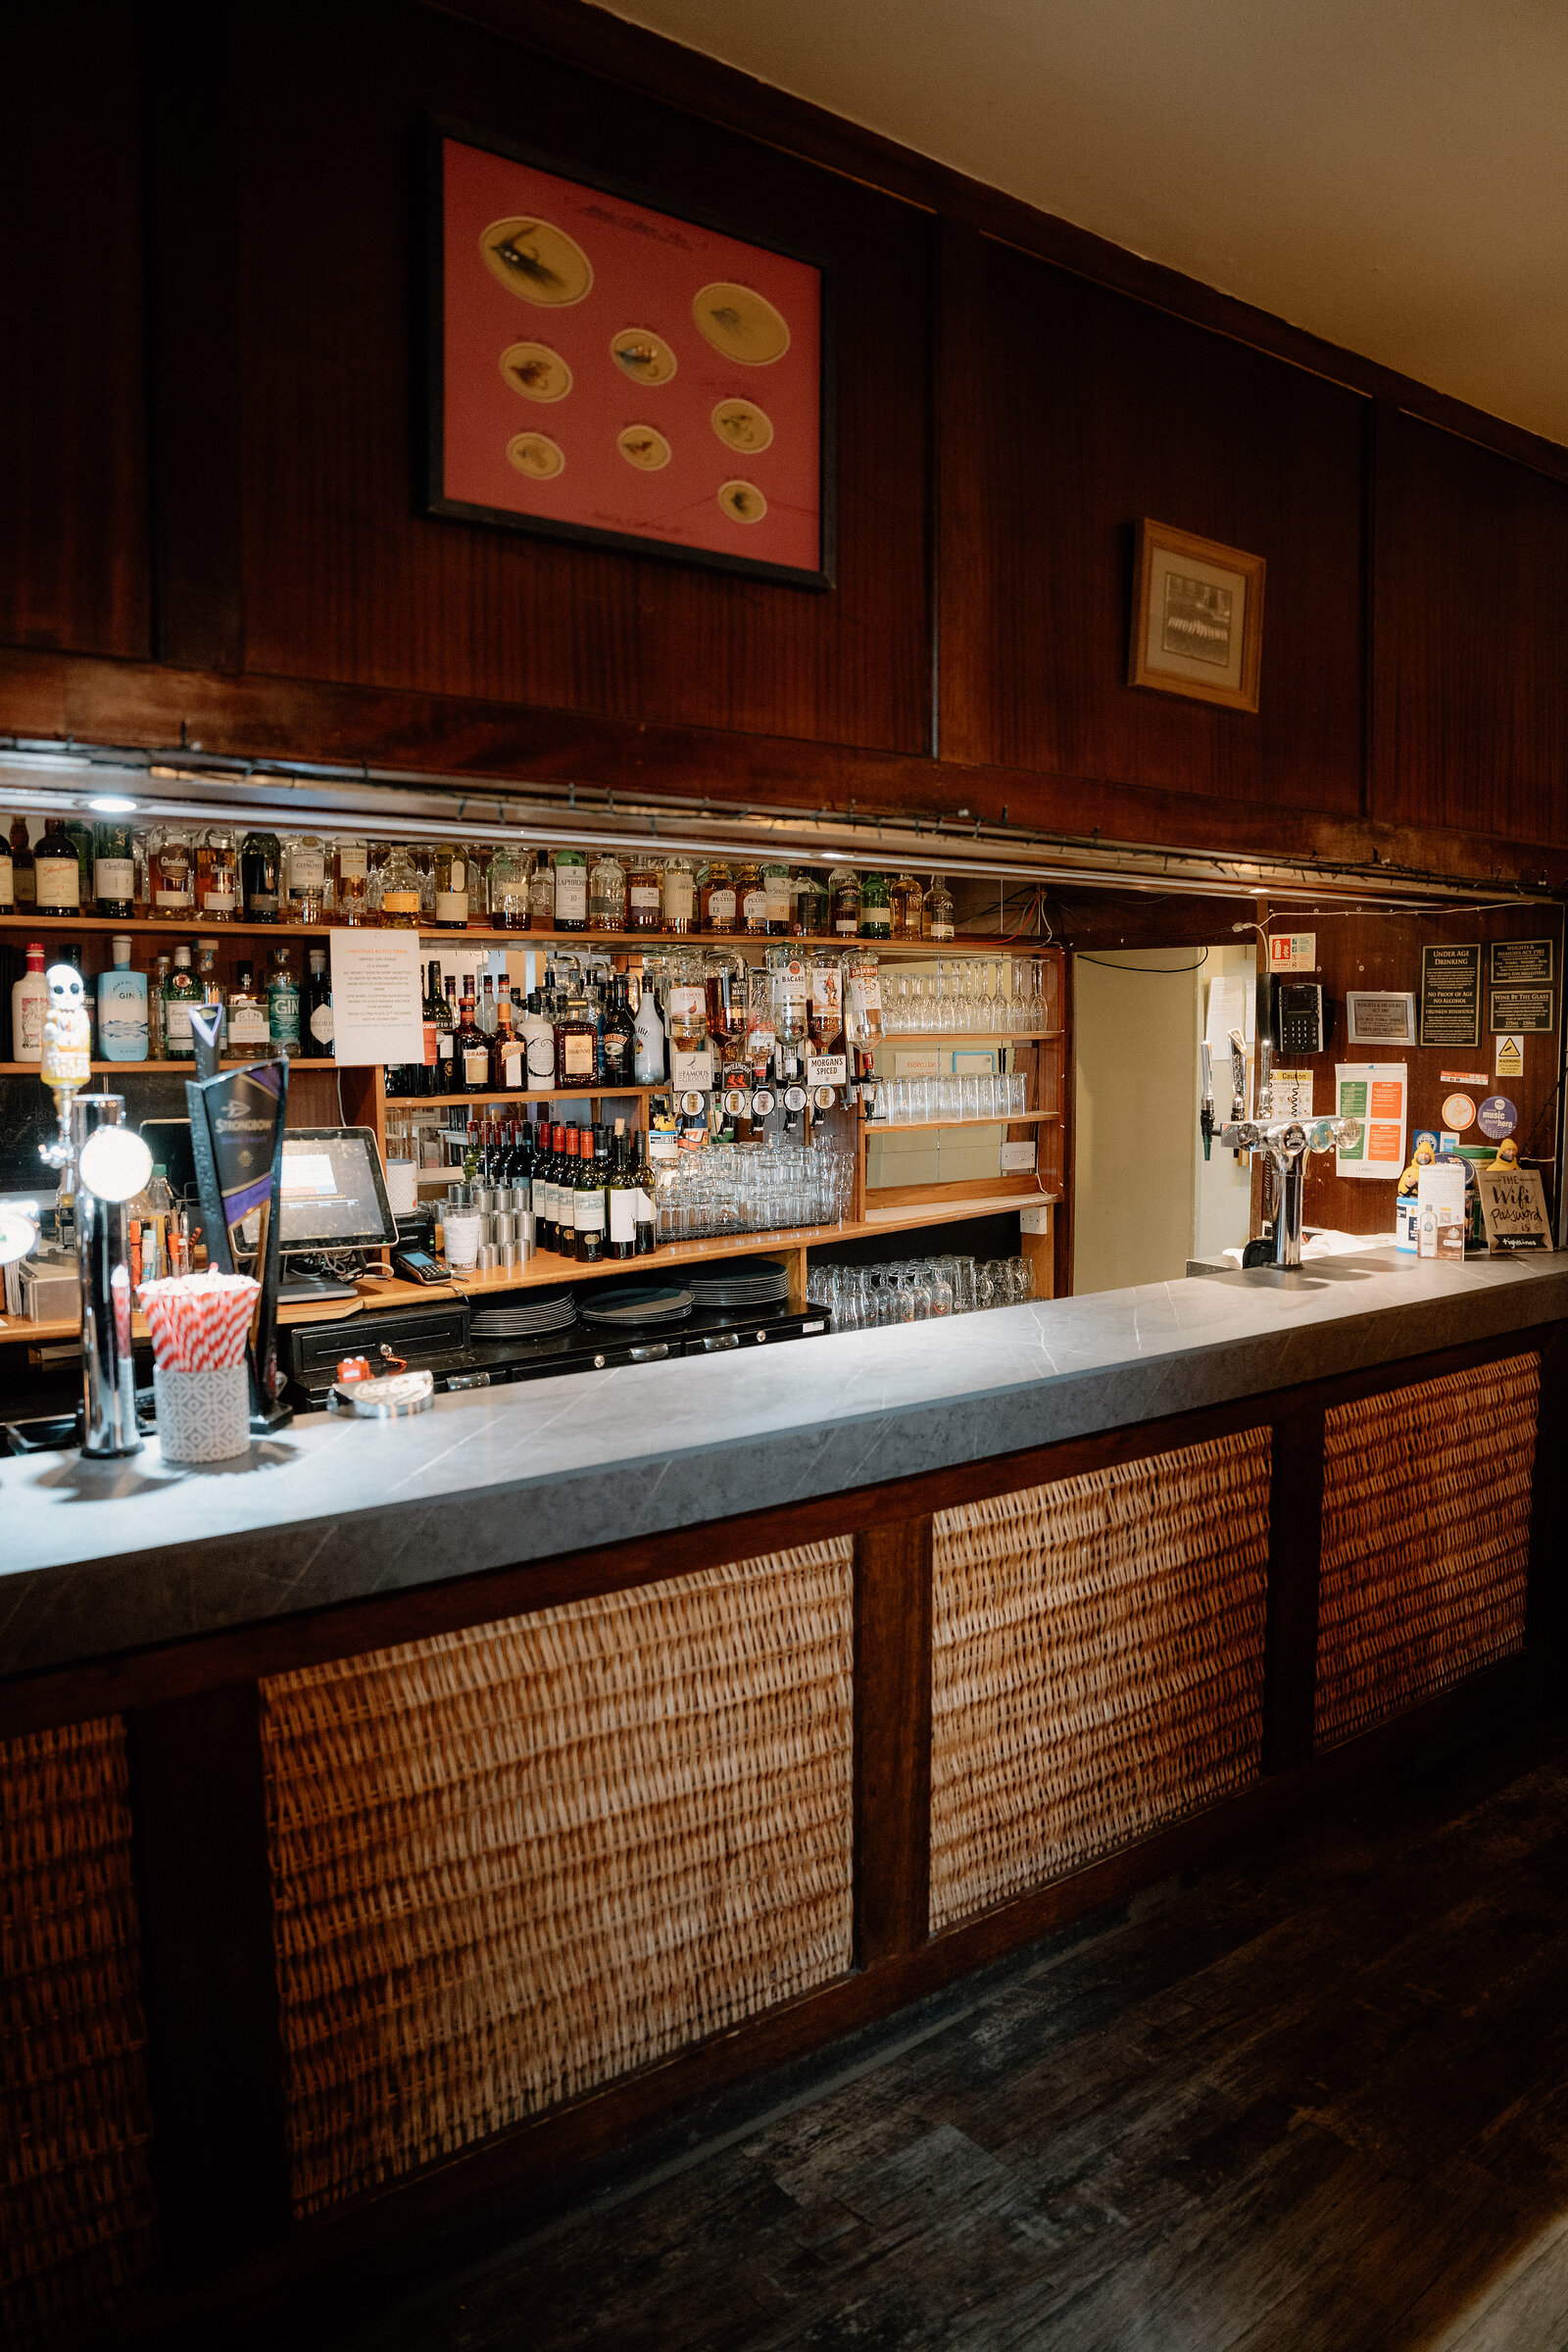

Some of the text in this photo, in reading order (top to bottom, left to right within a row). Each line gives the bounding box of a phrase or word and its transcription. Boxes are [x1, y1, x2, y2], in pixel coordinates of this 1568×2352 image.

[274, 1001, 300, 1014] GIN
[811, 1057, 843, 1066] MORGAN'S
[816, 1067, 837, 1076] SPICED
[216, 1118, 273, 1133] STRONGBOW
[1497, 1119, 1513, 1128] here
[1493, 1186, 1534, 1209] Wifi
[1521, 1223, 1530, 1232] is
